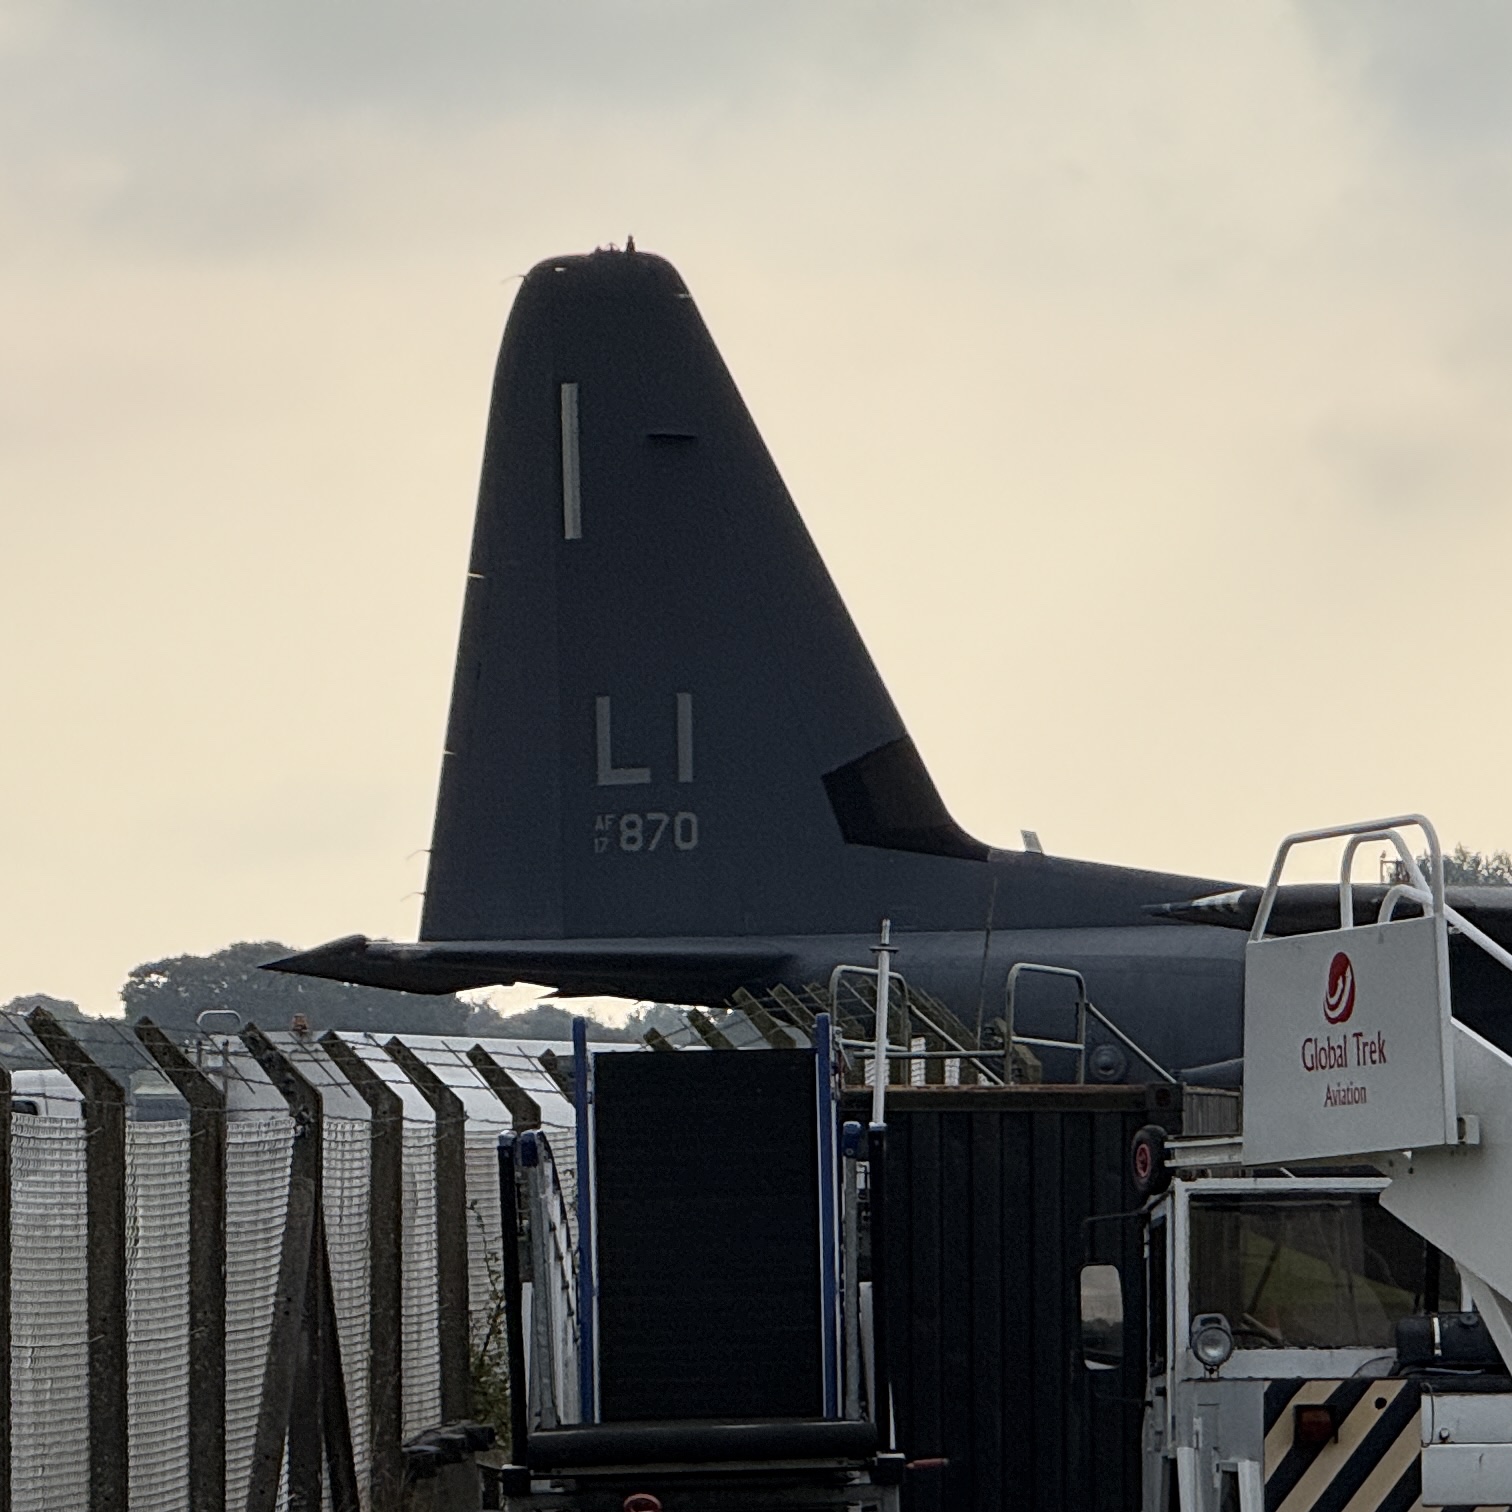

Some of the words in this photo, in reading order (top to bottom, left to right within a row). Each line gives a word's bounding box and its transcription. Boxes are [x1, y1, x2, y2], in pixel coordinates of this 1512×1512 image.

[595, 692, 694, 786] LI
[594, 813, 616, 831] AF
[619, 811, 699, 852] 870
[1301, 1034, 1348, 1072] Global
[1352, 1030, 1387, 1066] Trek
[1323, 1081, 1367, 1108] Aviation
